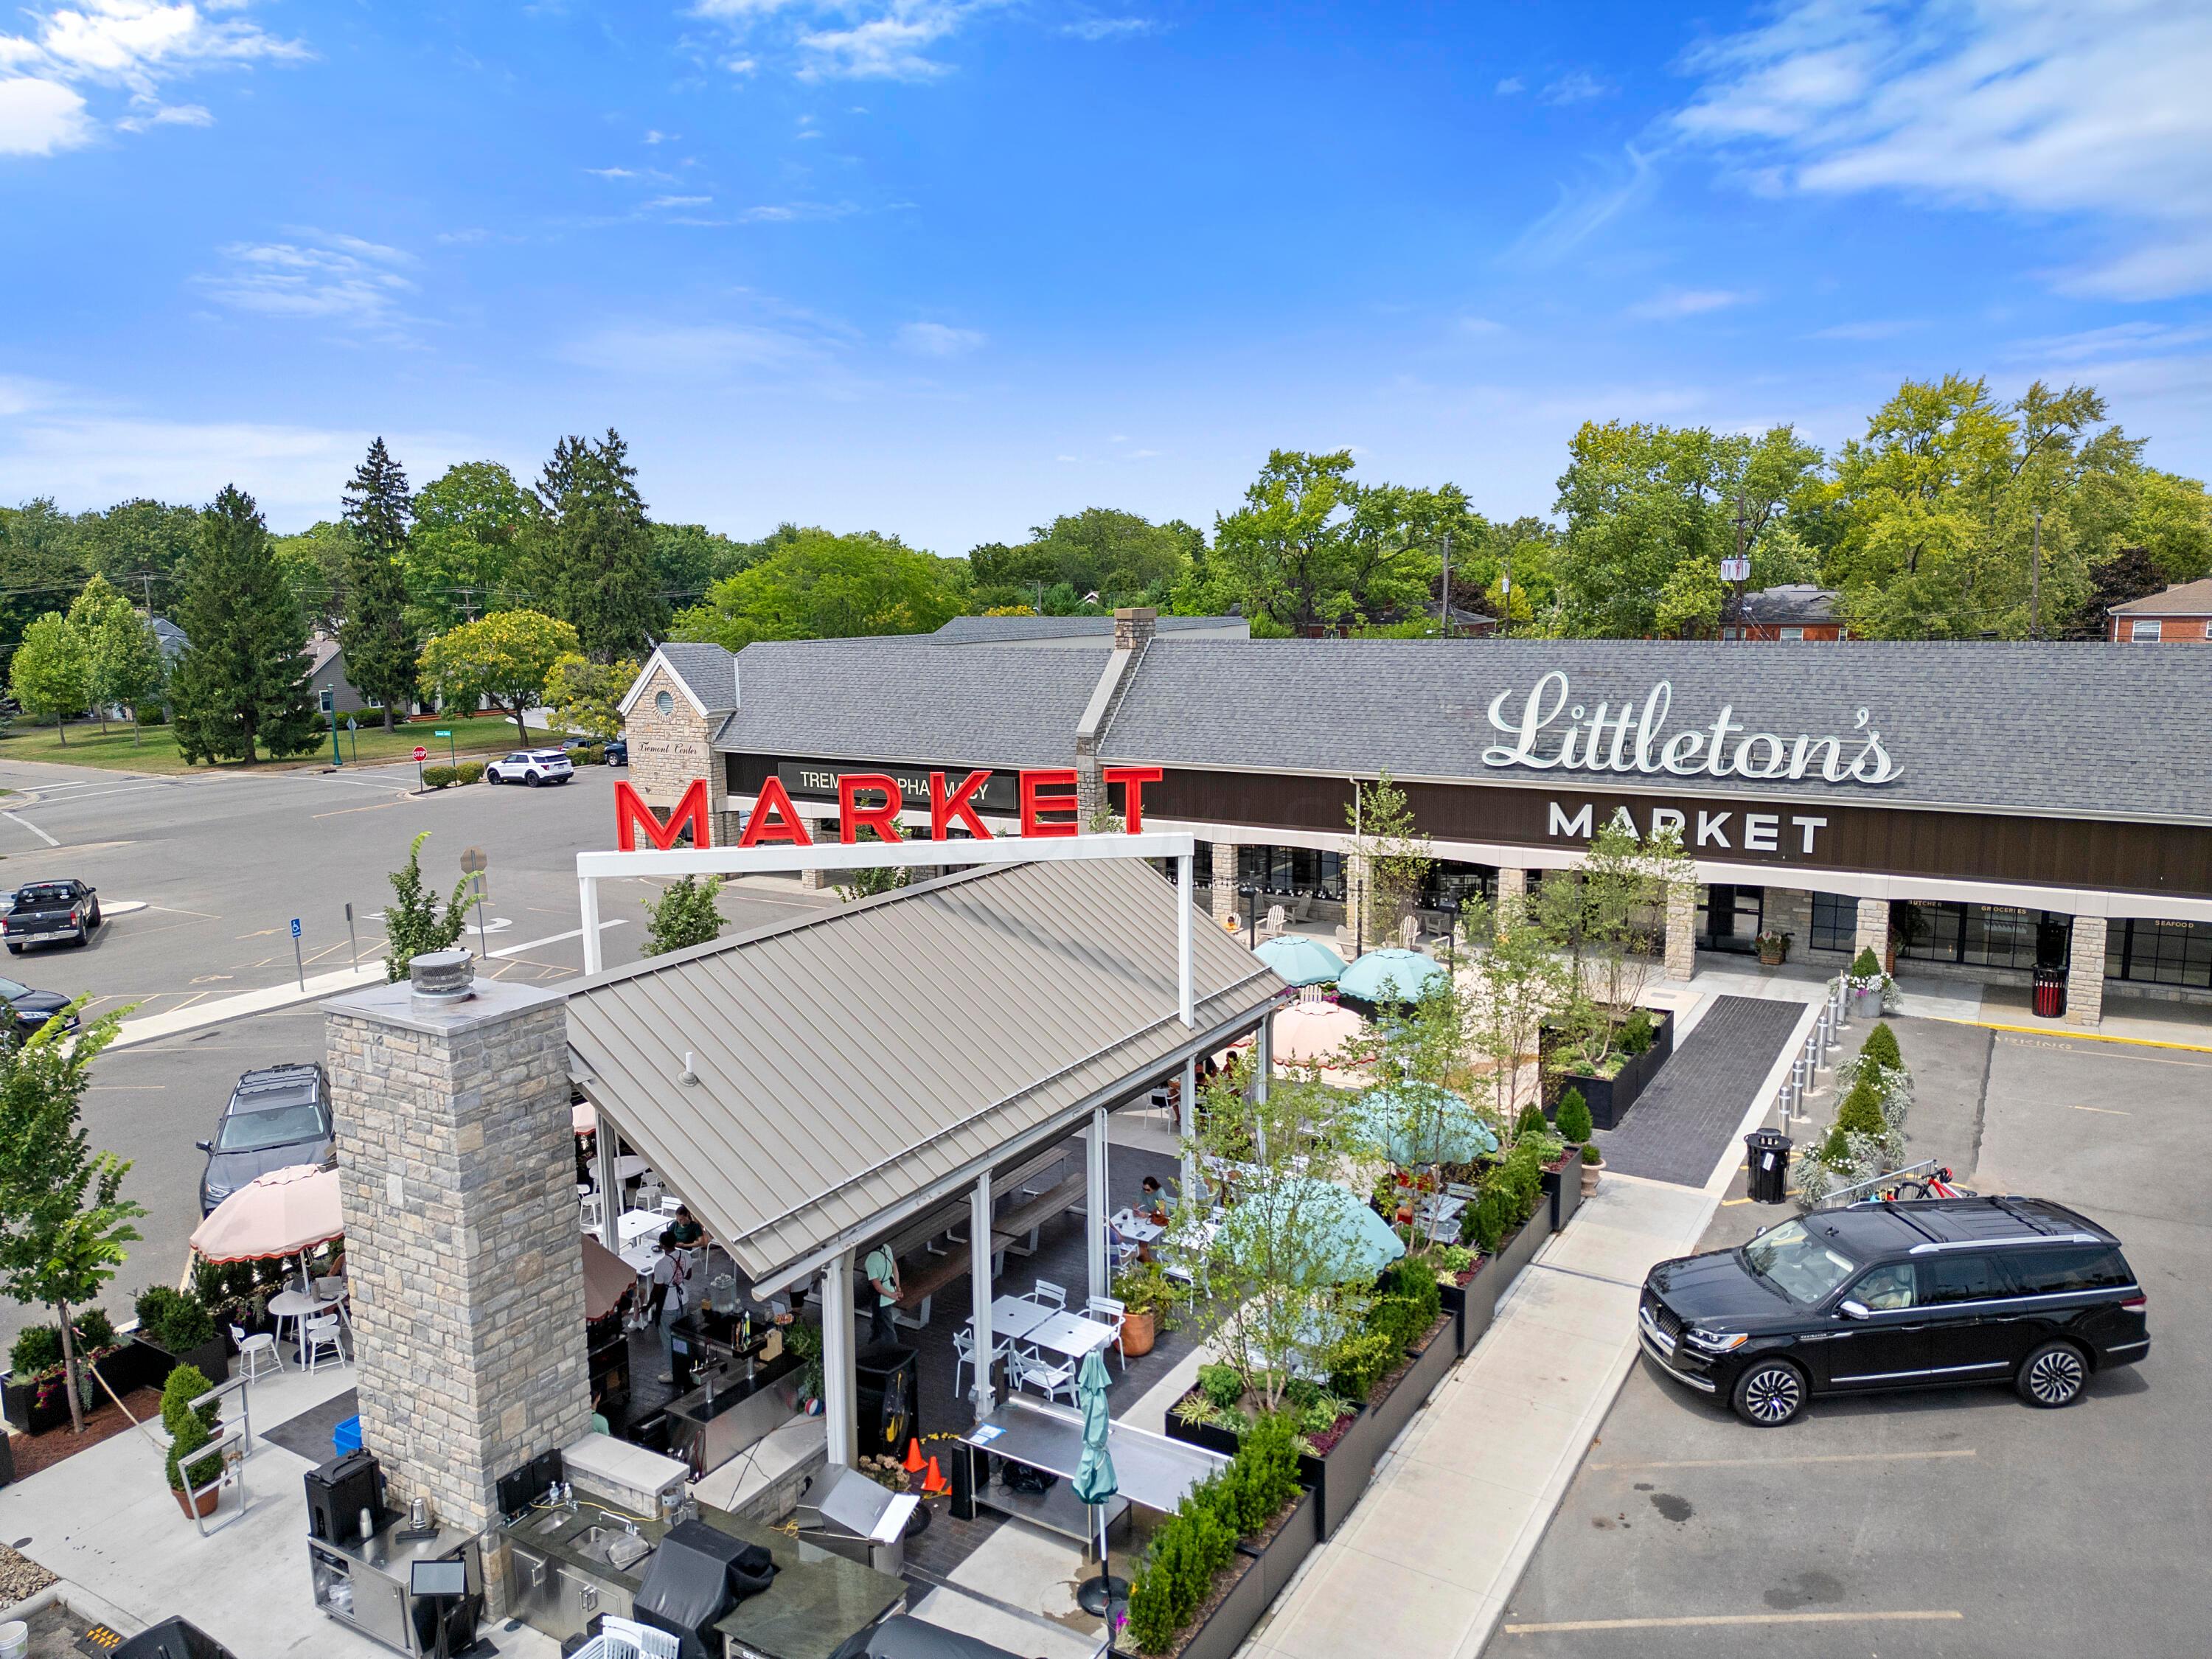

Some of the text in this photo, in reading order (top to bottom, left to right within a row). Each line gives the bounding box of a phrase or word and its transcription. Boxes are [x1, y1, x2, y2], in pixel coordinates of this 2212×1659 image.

[1481, 671, 1905, 783] Littleton's
[638, 741, 697, 754] Tremont Center
[800, 771, 873, 792] TREM
[614, 768, 1164, 852] MARKET
[1549, 801, 1827, 853] MARKET
[1981, 905, 2027, 914] GROCERIES
[2154, 919, 2194, 928] SEAFOOD
